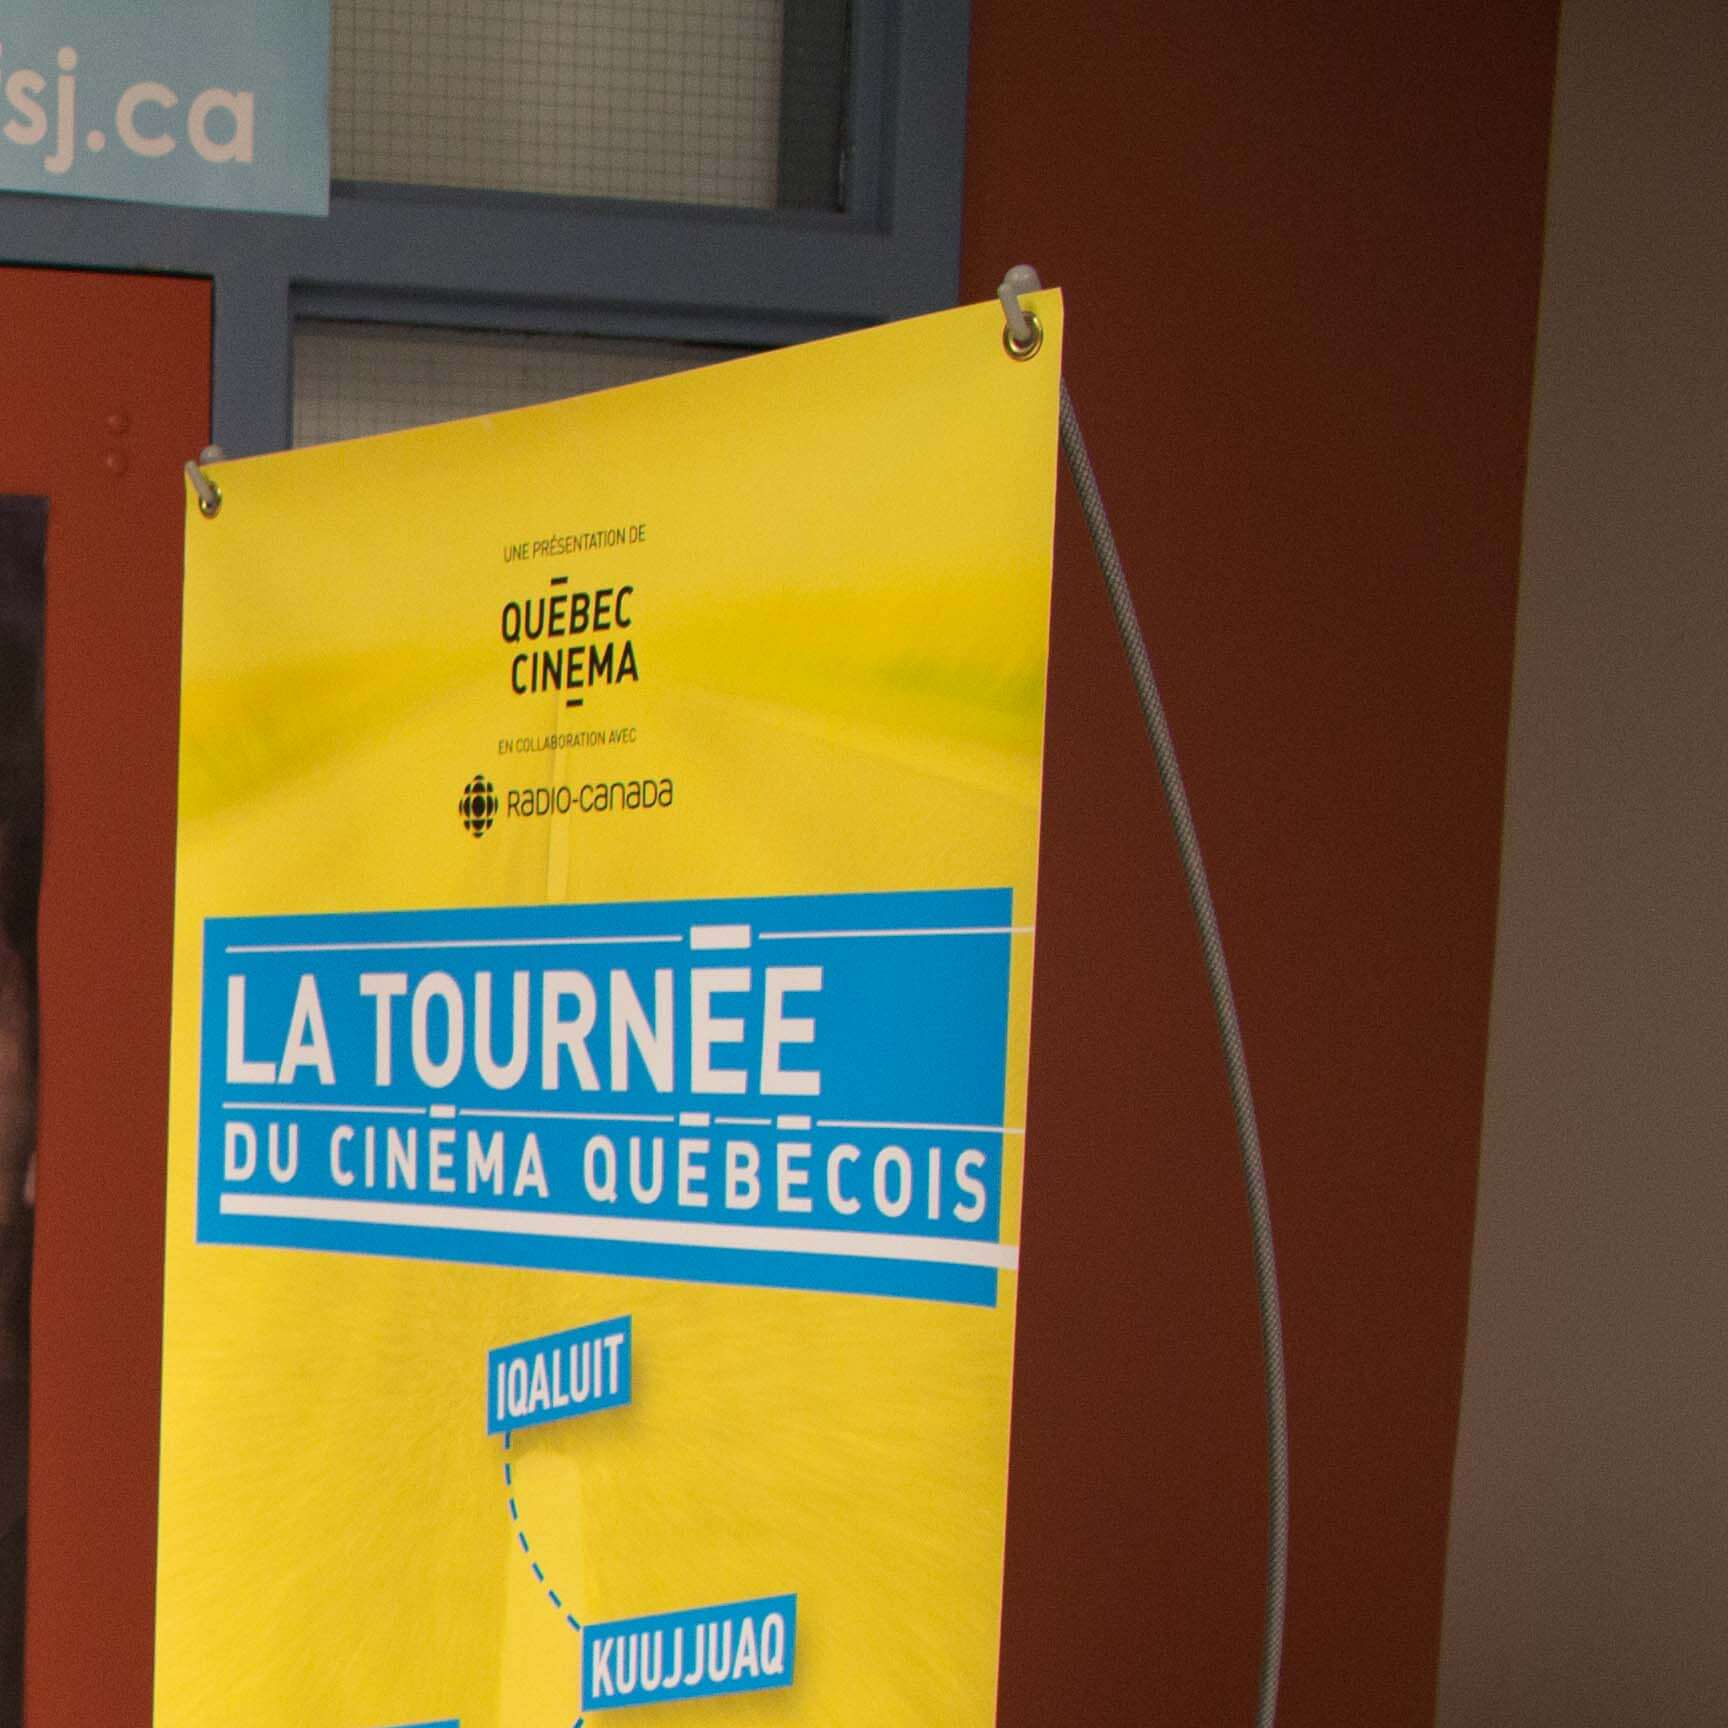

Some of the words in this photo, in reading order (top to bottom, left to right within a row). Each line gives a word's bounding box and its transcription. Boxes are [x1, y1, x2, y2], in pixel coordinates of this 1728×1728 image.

[503, 543, 530, 563] UNE
[532, 527, 626, 560] PRÉSENTATION
[629, 524, 647, 545] DE
[498, 738, 513, 755] EN
[515, 731, 606, 754] COLLABORATION
[608, 727, 638, 746] AVEC
[226, 972, 336, 1087] LA
[359, 924, 824, 1097] TOURNÉE
[222, 1120, 299, 1183] DU
[496, 1333, 625, 1422] IQALUIT
[591, 1612, 786, 1699] KUUJJUAQ
